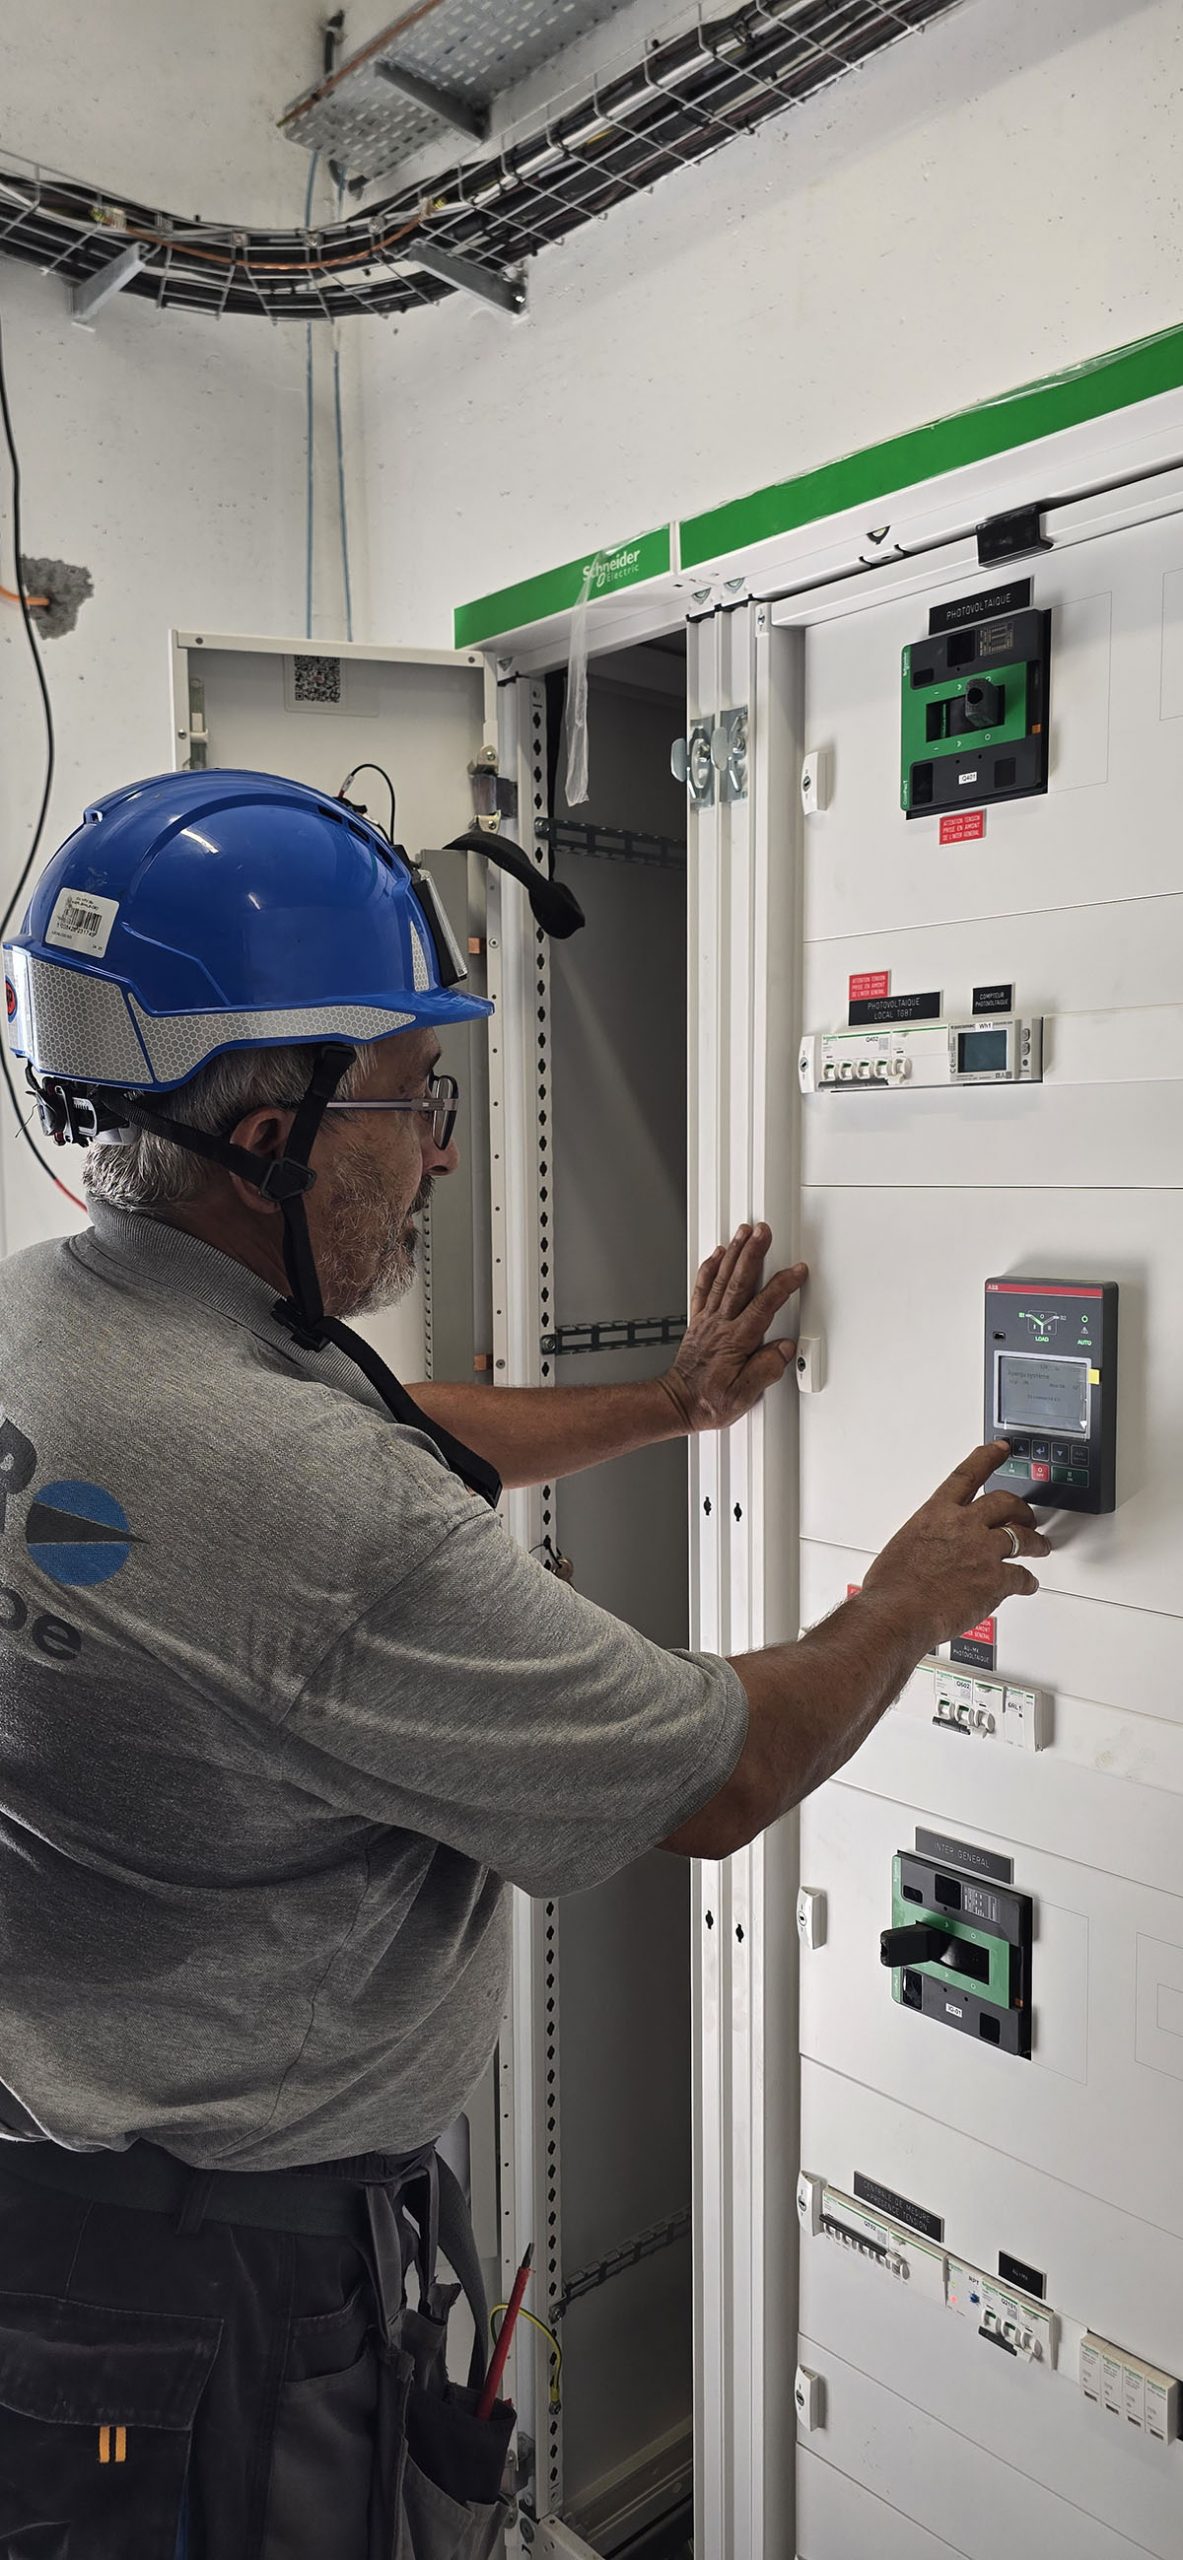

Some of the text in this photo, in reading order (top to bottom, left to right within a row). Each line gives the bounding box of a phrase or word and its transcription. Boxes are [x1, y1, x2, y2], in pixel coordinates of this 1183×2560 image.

[583, 550, 640, 582] Schneider
[607, 564, 639, 582] Electric
[946, 593, 1011, 620] PHOTOVOLTAIQUE
[867, 997, 920, 1010] PHOTOVOLTAIQUE
[979, 992, 1005, 1000] COMPTEUR
[874, 1011, 893, 1020] LOCAL
[957, 1849, 990, 1869] GENERAL
